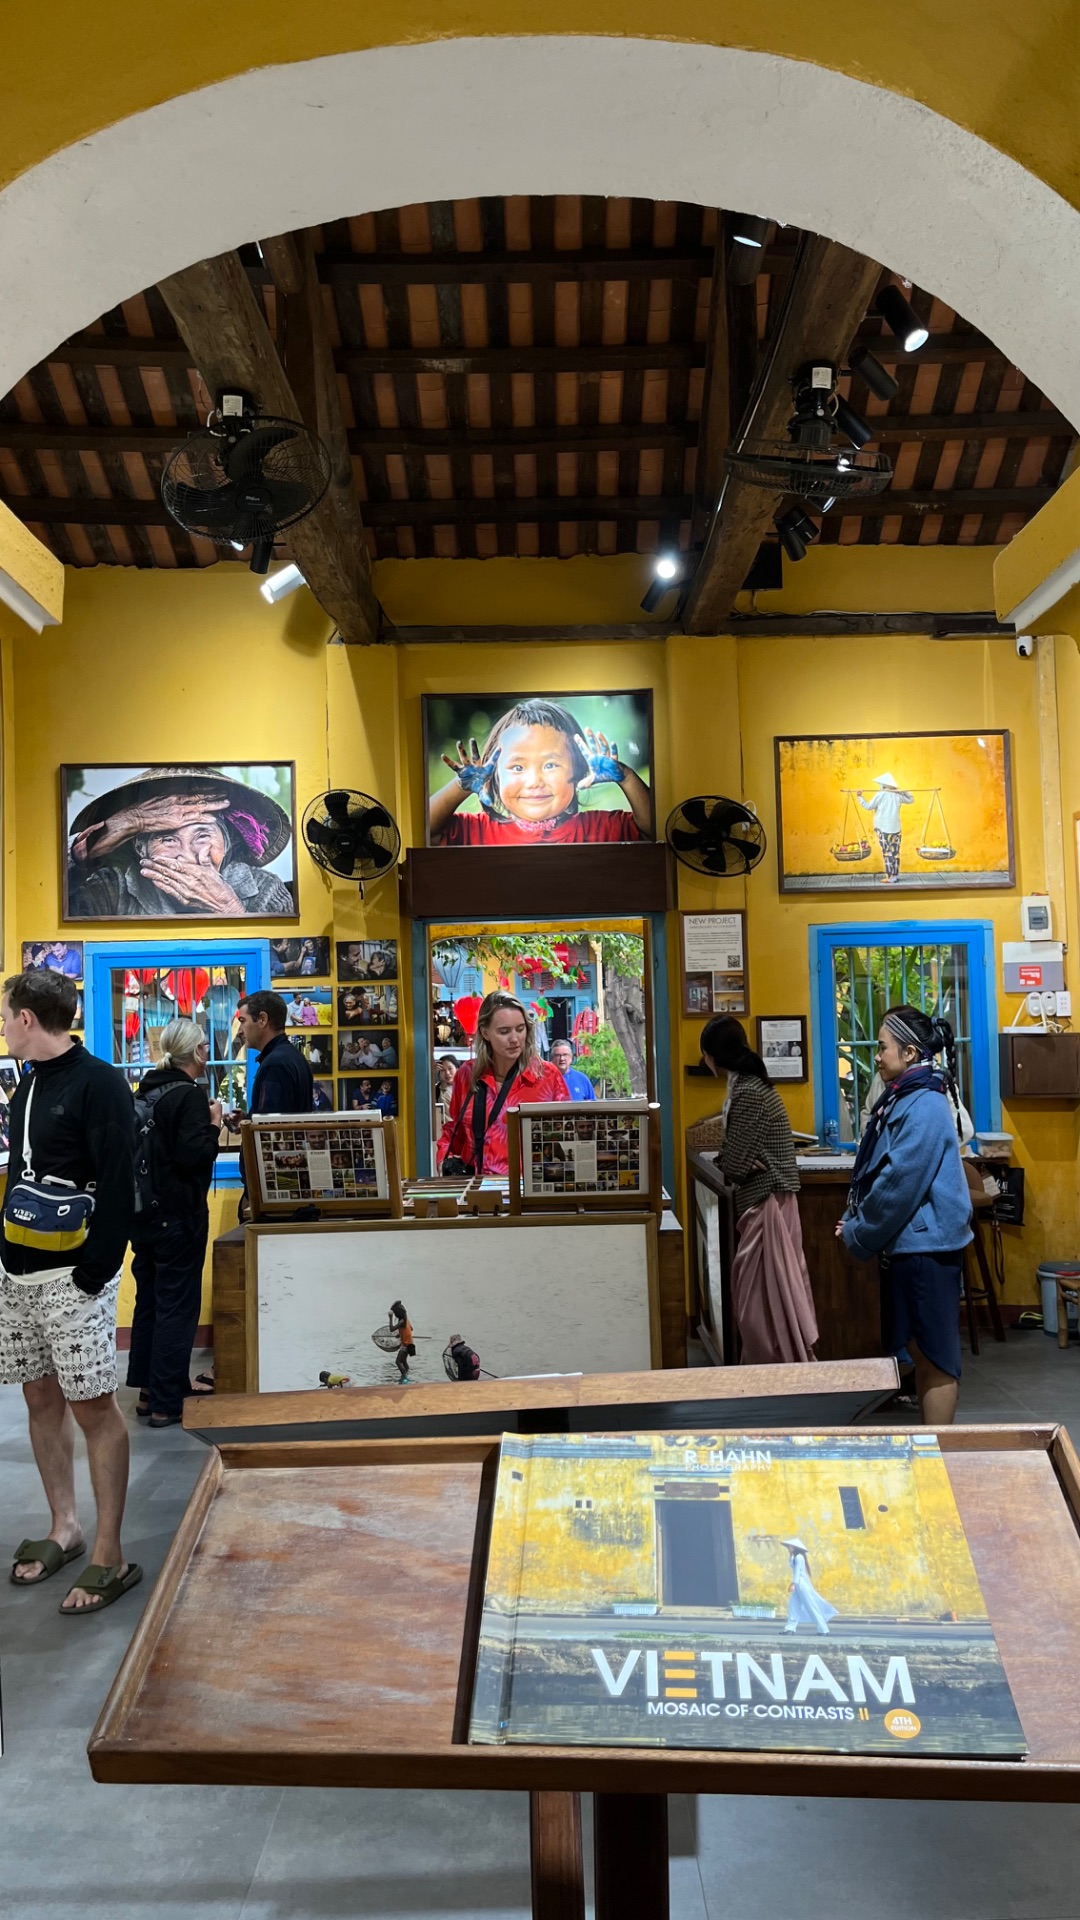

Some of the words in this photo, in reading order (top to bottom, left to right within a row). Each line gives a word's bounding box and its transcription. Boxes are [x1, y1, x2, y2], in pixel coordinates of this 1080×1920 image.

[685, 1450, 772, 1464] RHAHN
[685, 1463, 772, 1472] PHOTOGRAPHY
[590, 1648, 916, 1703] VIETNAM
[648, 1701, 721, 1716] MOSAIC
[725, 1703, 749, 1717] OF
[753, 1704, 855, 1720] CONTRASTS
[892, 1716, 912, 1725] 4TH
